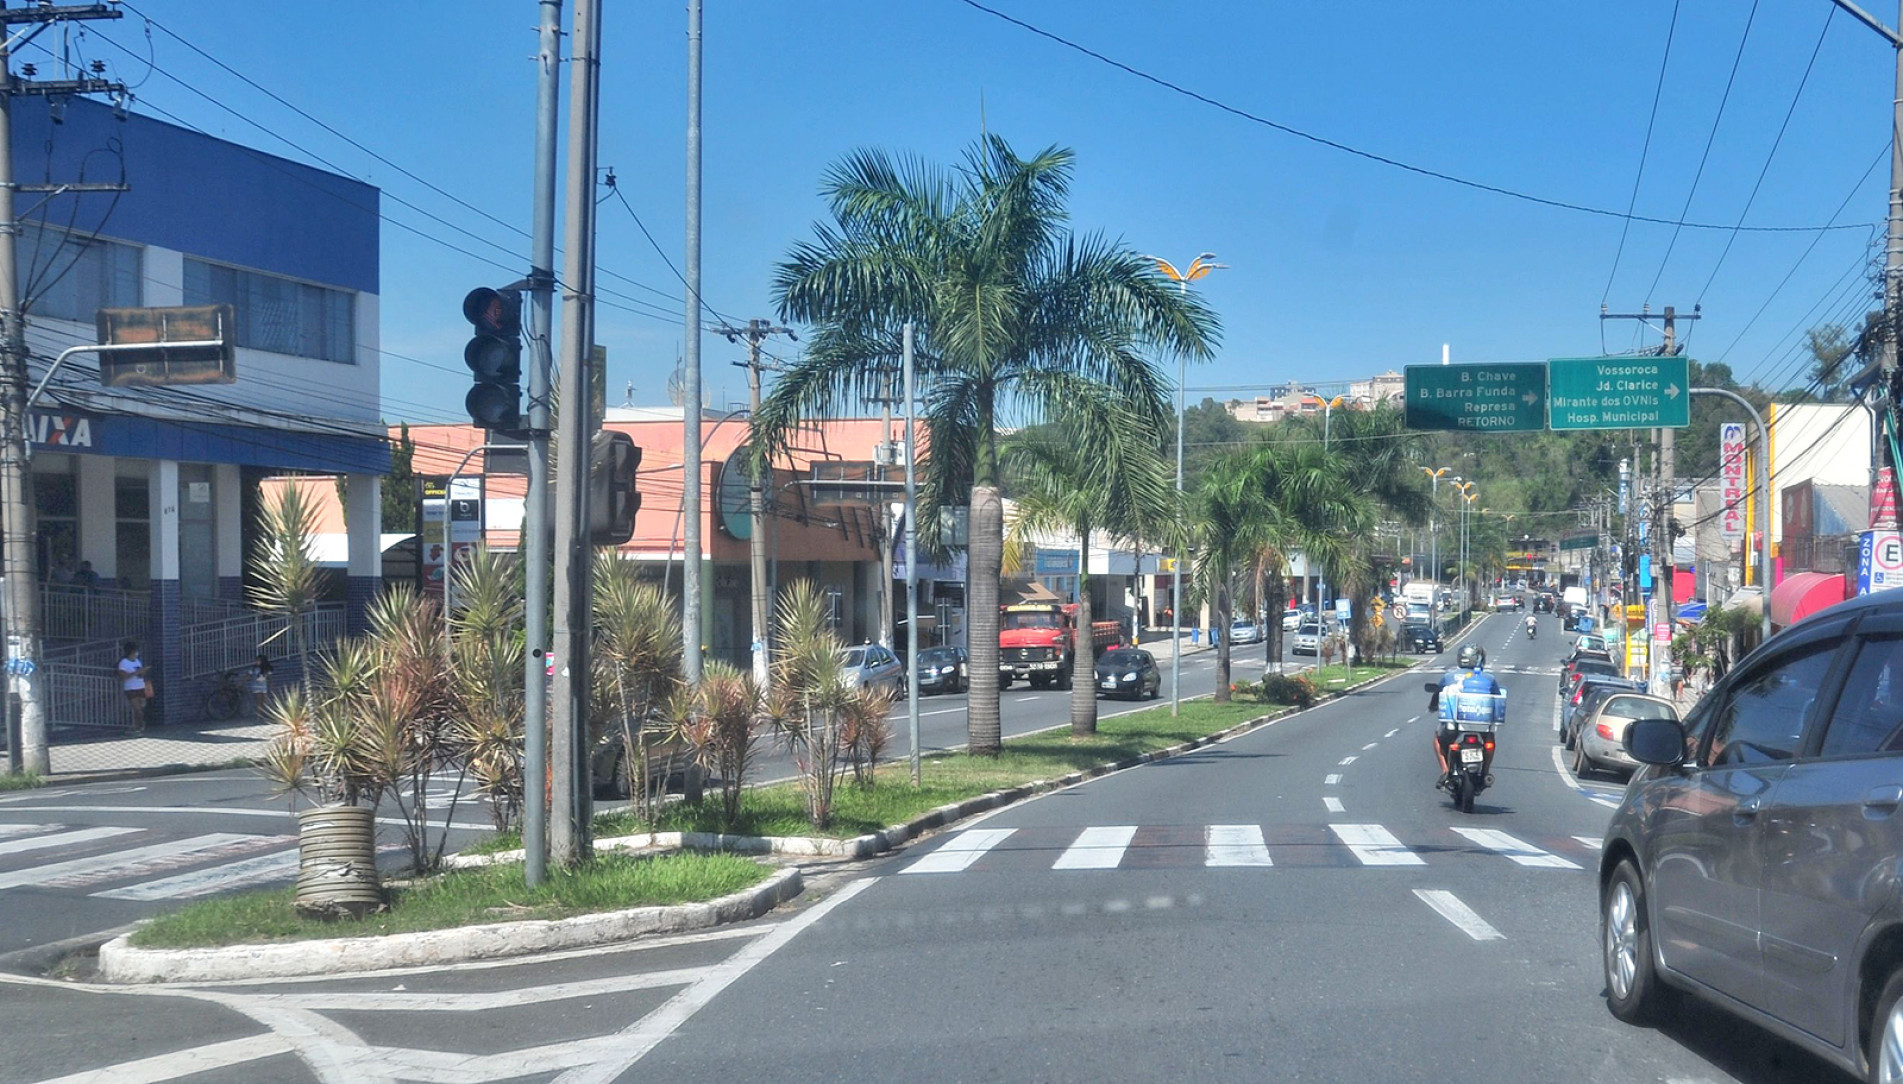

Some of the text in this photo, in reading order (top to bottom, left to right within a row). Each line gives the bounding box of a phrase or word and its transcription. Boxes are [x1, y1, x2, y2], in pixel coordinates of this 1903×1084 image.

[1461, 371, 1516, 382] B. Chave
[1597, 365, 1659, 376] Vossoroca
[1420, 386, 1516, 399] B. Barra Funda
[1595, 380, 1659, 392] Jd. Clarice
[1464, 402, 1516, 413] Represa
[1553, 395, 1659, 408] Mirante dos OVNIs
[1457, 416, 1515, 427] RETORNO
[1567, 410, 1659, 425] Hosp. Municipal
[1723, 442, 1743, 532] MONTREAL
[1860, 538, 1871, 576] ZONA
[1885, 543, 1899, 562] E
